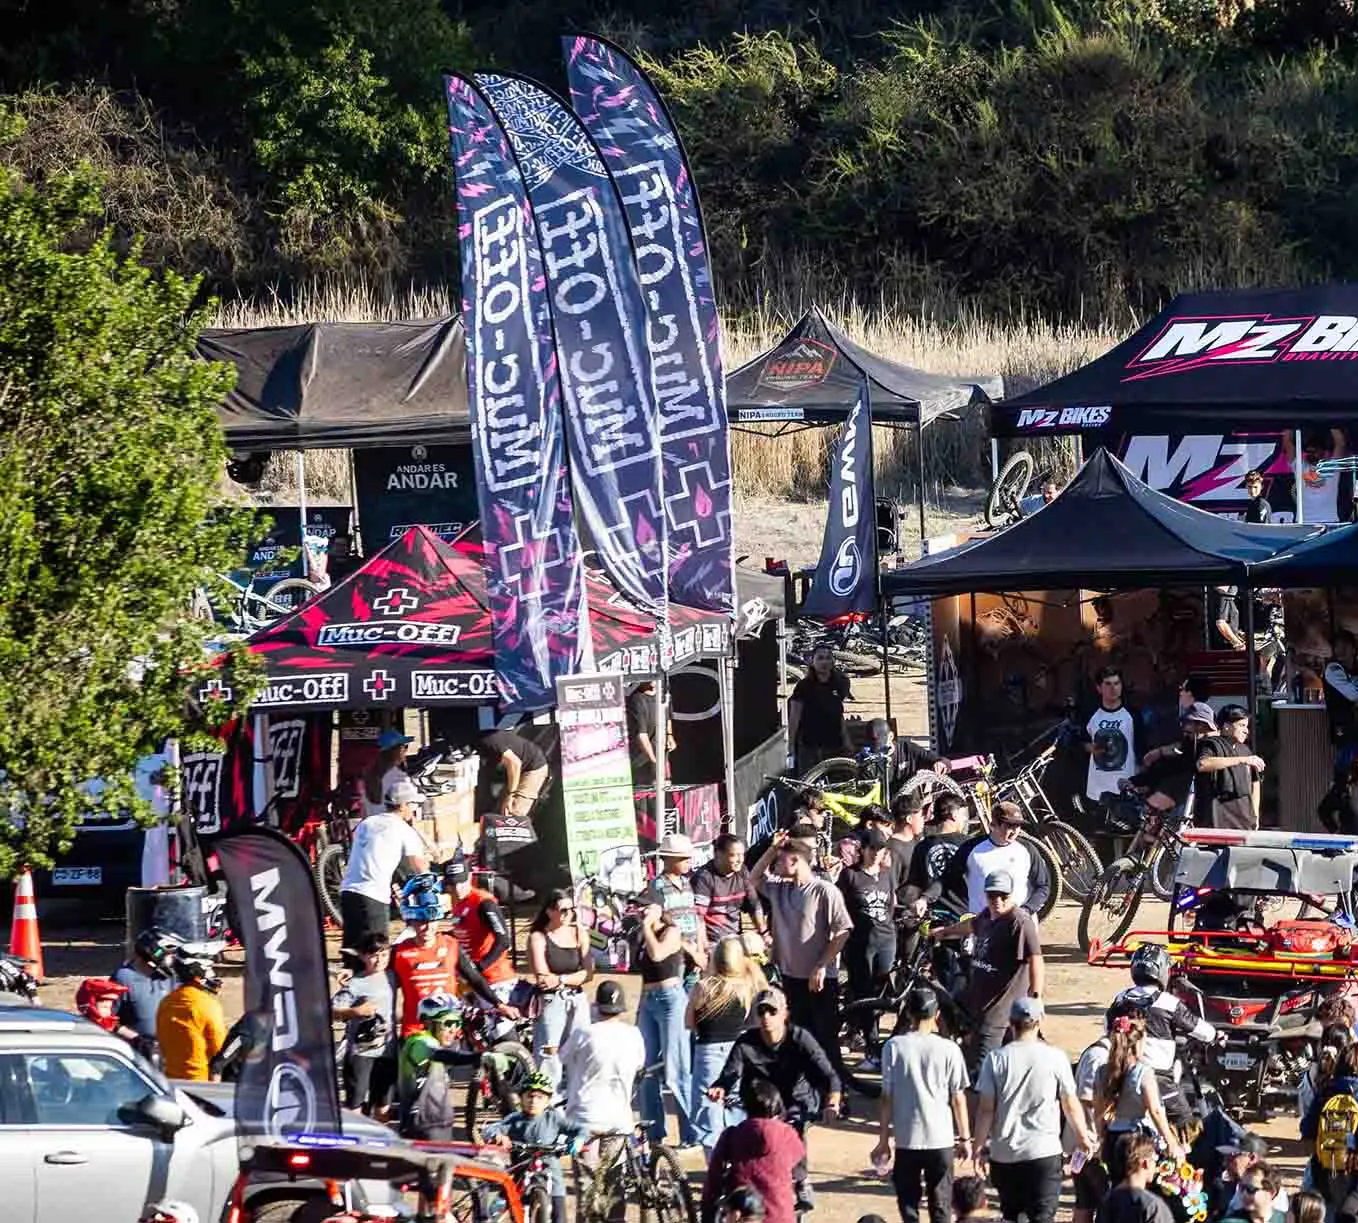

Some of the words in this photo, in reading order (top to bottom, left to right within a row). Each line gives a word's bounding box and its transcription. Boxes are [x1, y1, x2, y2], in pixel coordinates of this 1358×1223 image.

[740, 410, 761, 419] NIPA
[1059, 406, 1113, 425] BIKES
[397, 464, 446, 473] ANDARES
[387, 472, 458, 490] ANDAR
[325, 625, 453, 643] Muc-Off
[416, 673, 498, 697] Muc-Of
